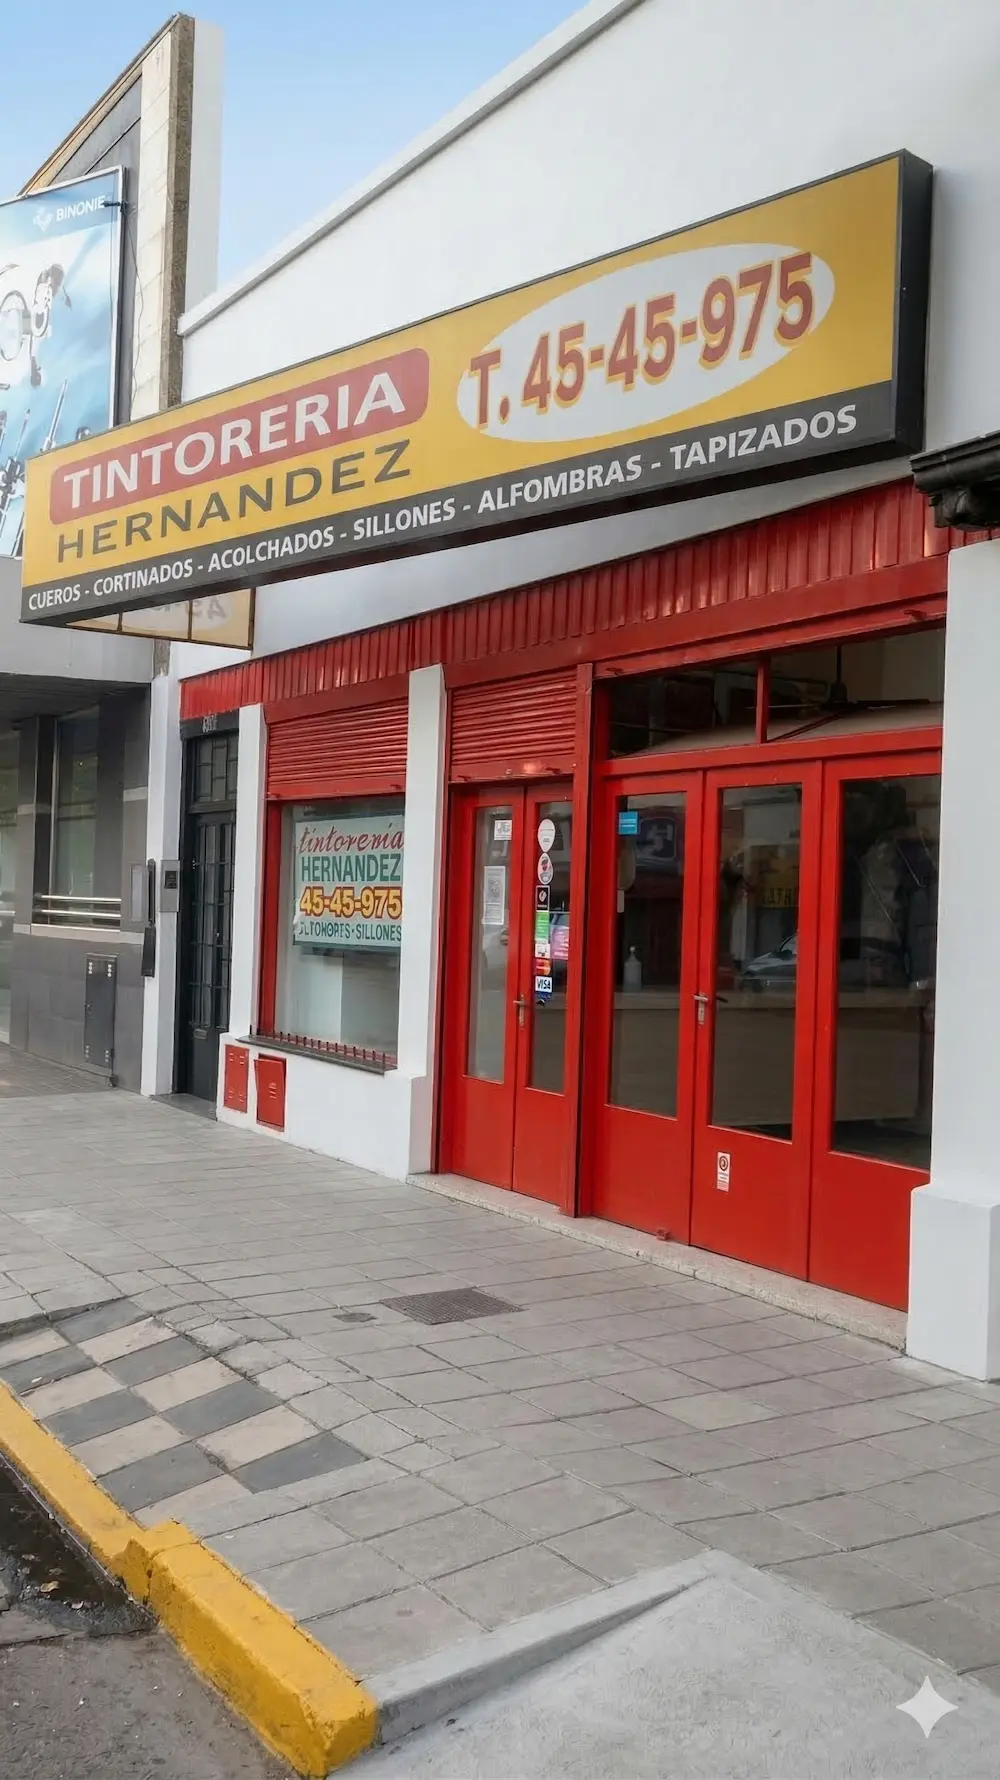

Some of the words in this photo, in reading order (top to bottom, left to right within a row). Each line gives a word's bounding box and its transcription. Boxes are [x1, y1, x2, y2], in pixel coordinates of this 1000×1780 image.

[522, 254, 813, 408] 45-45-975
[57, 438, 411, 563] HERNANDEZ
[63, 371, 407, 509] TINTORERIA
[28, 583, 81, 611] CUEROS
[93, 558, 194, 597] CORTINADOS
[207, 525, 335, 573] ACOLCHADOS
[353, 497, 456, 541] SILLONES
[477, 454, 642, 514] ALFOMBRAS
[669, 404, 857, 470] TAPIZADOS
[300, 885, 402, 919] 45-45-975
[301, 853, 402, 883] HERNANDEZ
